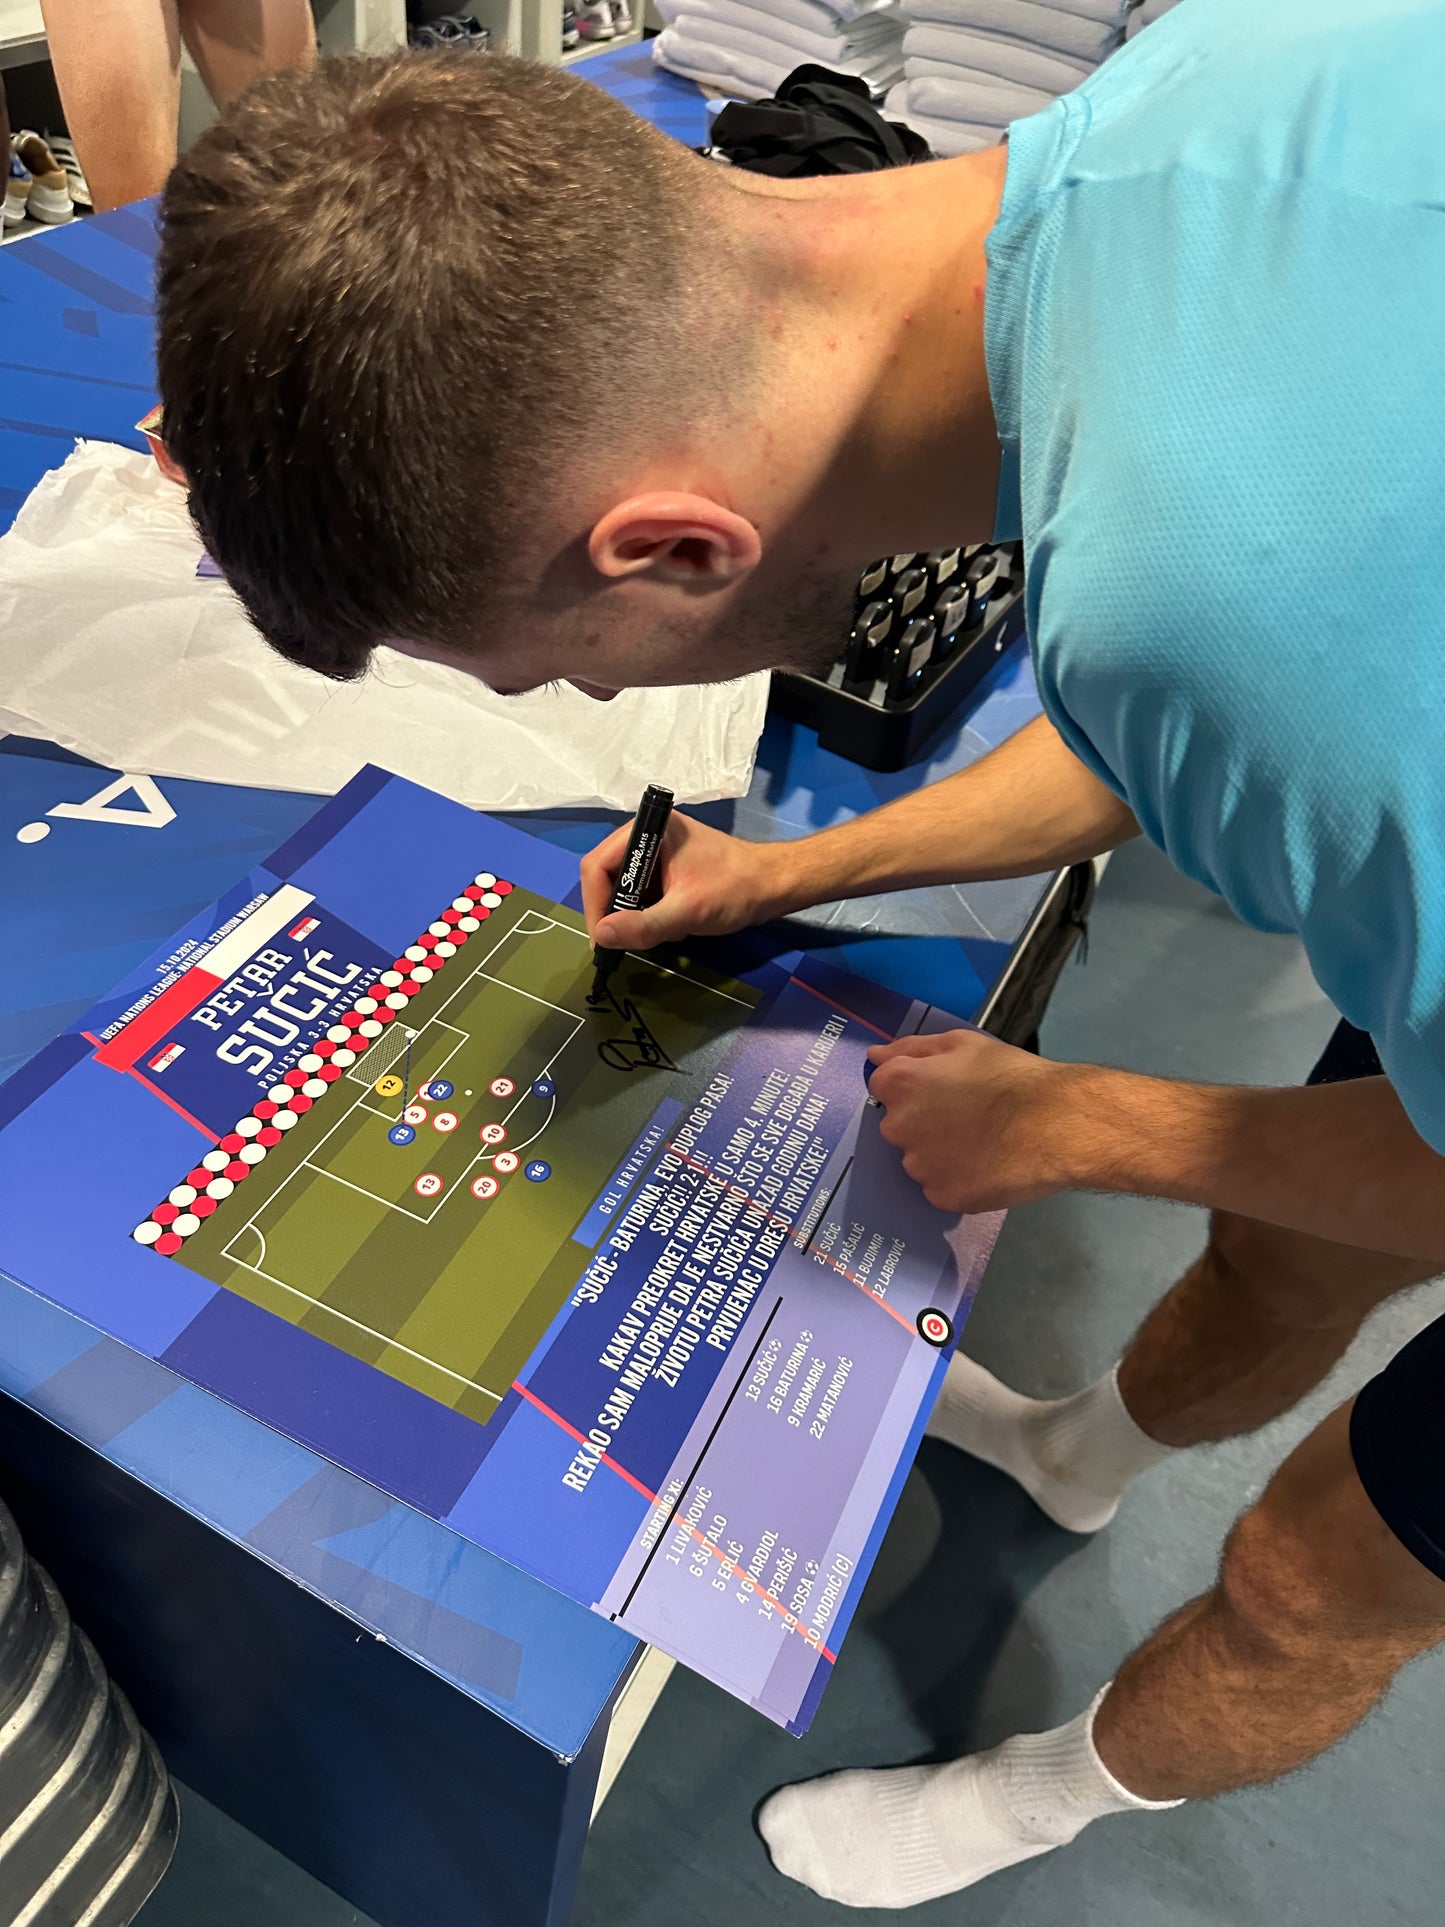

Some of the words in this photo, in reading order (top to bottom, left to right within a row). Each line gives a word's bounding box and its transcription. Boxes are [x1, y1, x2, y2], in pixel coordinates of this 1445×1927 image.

[621, 848, 644, 893] Sharpie
[640, 832, 649, 850] M15
[635, 856, 651, 895] Permanent
[646, 833, 658, 858] Marker
[100, 1018, 126, 1041] UEFA
[121, 992, 155, 1024] NATIONS
[179, 941, 215, 974] NATIONAL
[208, 914, 242, 945] STADIUM
[236, 892, 270, 923] WARSAW
[155, 938, 199, 975] 15.10.2024
[190, 948, 293, 1031] PETAR
[216, 948, 363, 1076] SUČIĆ
[257, 1041, 310, 1090] POLJSKA
[307, 1020, 330, 1039] 3-3
[328, 966, 383, 1018] HRVATSKA
[832, 1014, 848, 1023] I
[805, 1020, 846, 1066] KARIJERI
[382, 1079, 396, 1090] 12
[495, 1081, 510, 1093] 21
[800, 1061, 819, 1076] U
[433, 1084, 449, 1097] 22
[750, 1067, 791, 1116] MINUTE!
[774, 1074, 814, 1121] DOGAĐA
[394, 1128, 410, 1141] 13
[487, 1128, 501, 1139] 10
[743, 1116, 764, 1129] 4.
[761, 1118, 787, 1145] SVE
[501, 1158, 511, 1166] 3
[722, 1126, 756, 1165] SAMO
[751, 1142, 774, 1162] SE
[422, 1178, 435, 1191] 13
[477, 1181, 492, 1194] 20
[530, 1164, 545, 1178] 16
[598, 1191, 622, 1215] GOL
[616, 1124, 665, 1188] HRVATSKA!
[714, 1161, 734, 1176] U
[733, 1158, 764, 1187] ŠTO
[779, 1136, 829, 1214] HRVATSKE!"
[570, 1255, 618, 1307] "SUČIĆ
[609, 1183, 670, 1253] BATURINA,
[654, 1152, 684, 1182] EVO
[670, 1106, 713, 1156] DUPLOG
[700, 1072, 735, 1110] PASA!
[649, 1183, 693, 1237] SUČIĆ!!
[680, 1149, 714, 1187] 2-1!!!
[674, 1172, 729, 1245] HRVATSKE
[691, 1185, 749, 1265] NESTVARNO
[755, 1211, 793, 1259] DRESU
[793, 1187, 832, 1249] SUBSTITUTIONS:
[820, 1221, 841, 1252] SUČIĆ
[650, 1326, 701, 1388] ŽIVOTU
[686, 1279, 728, 1330] PETRA
[714, 1227, 756, 1281] SUČIĆA
[741, 1175, 784, 1229] UNAZAD
[771, 1129, 809, 1176] GODINU
[796, 1093, 829, 1132] DANA!
[814, 1251, 828, 1265] 21
[839, 1222, 865, 1263] PAŠALIĆ
[858, 1233, 886, 1275] BUDIMIR
[631, 1238, 689, 1317] PREOKRET
[681, 1261, 706, 1283] JE
[748, 1255, 769, 1271] U
[833, 1260, 847, 1276] 15
[853, 1272, 868, 1288] 11
[878, 1238, 906, 1285] LABROVIĆ
[668, 1279, 697, 1306] DA
[706, 1268, 763, 1351] PRVIJENAC
[872, 1283, 887, 1299] 12
[598, 1312, 646, 1372] KAKAV
[619, 1301, 684, 1391] MALOPRIJE
[752, 1350, 778, 1386] SUČIĆ
[774, 1342, 809, 1398] BATURINA
[791, 1357, 827, 1417] KRAMARIĆ
[745, 1384, 761, 1402] 13
[766, 1395, 783, 1415] 16
[816, 1355, 854, 1423] MATANOVIĆ
[597, 1386, 636, 1431] SAM
[787, 1415, 801, 1427] 9
[809, 1420, 826, 1440] 22
[561, 1428, 612, 1493] REKAO
[639, 1494, 676, 1550] STARTING
[667, 1478, 685, 1495] XI:
[670, 1485, 713, 1554] LIVAKOVIĆ
[691, 1513, 728, 1567] ŠUTALO
[717, 1539, 744, 1579] ERLIĆ
[665, 1553, 681, 1566] 1
[688, 1564, 704, 1578] 6
[740, 1529, 779, 1593] GVARDIOL
[766, 1547, 798, 1601] PERIŠIĆ
[712, 1579, 726, 1592] 5
[735, 1592, 750, 1605] 4
[789, 1576, 815, 1614] SOSA
[812, 1568, 844, 1625] MODRIĆ
[758, 1599, 776, 1621] 14
[780, 1613, 799, 1635] 19
[804, 1626, 821, 1649] 10
